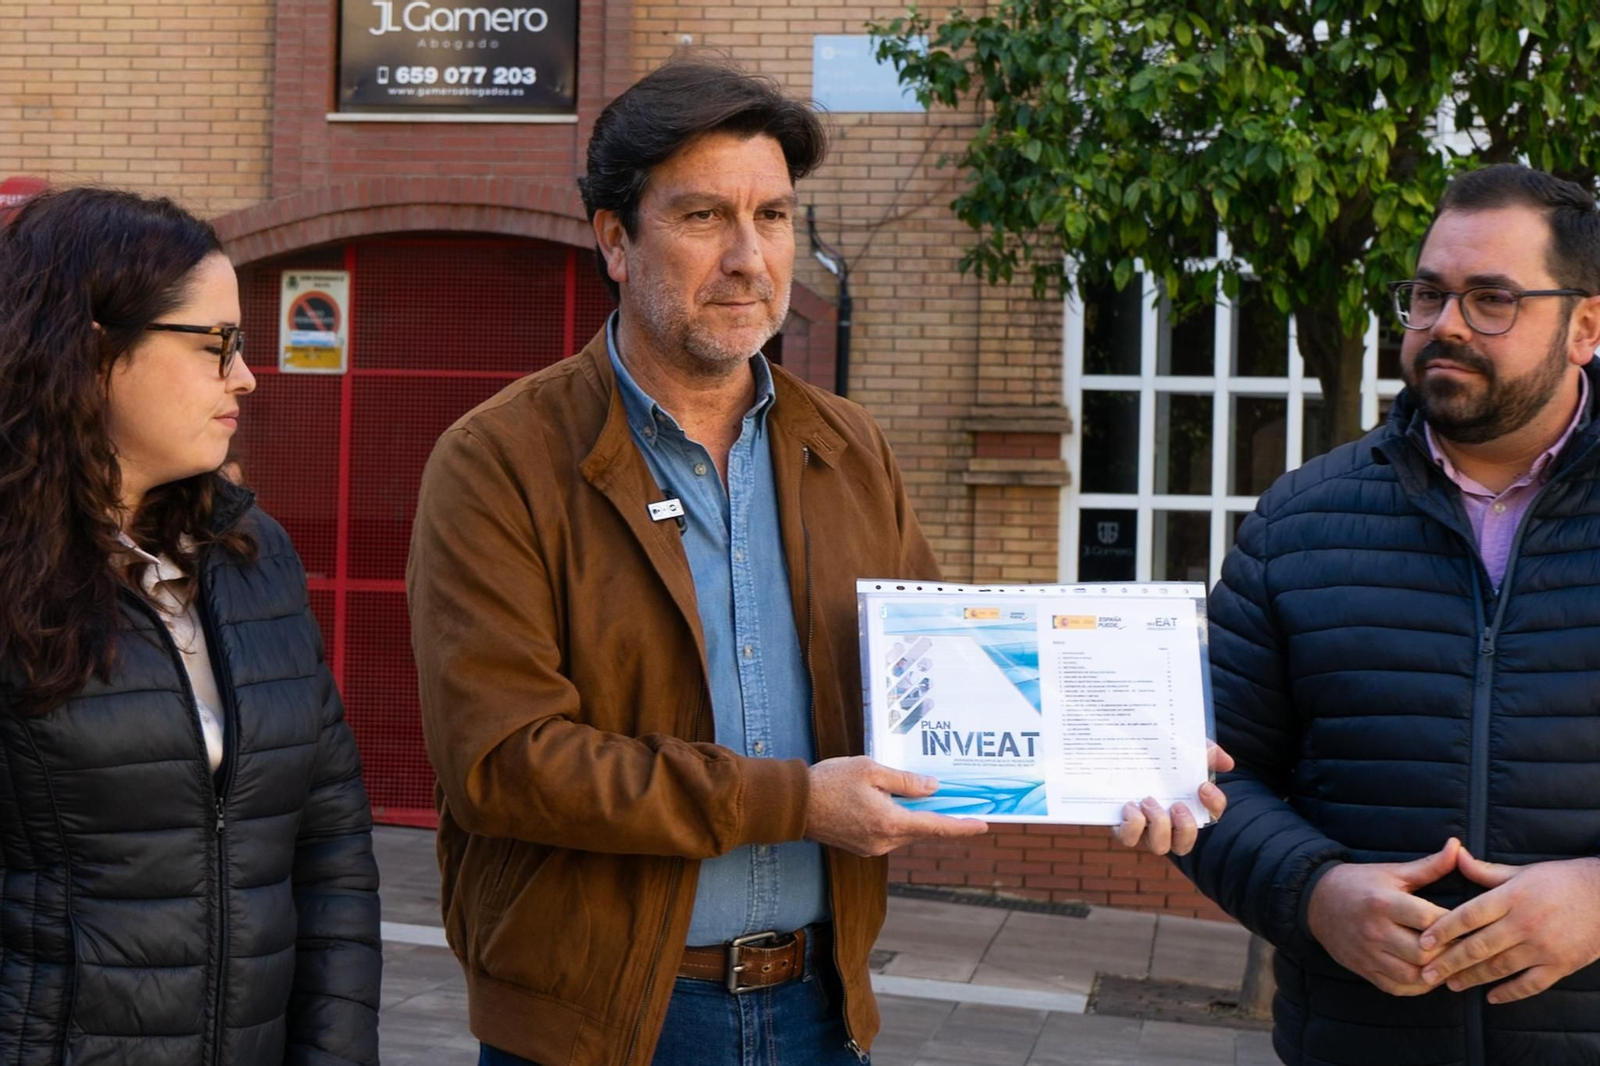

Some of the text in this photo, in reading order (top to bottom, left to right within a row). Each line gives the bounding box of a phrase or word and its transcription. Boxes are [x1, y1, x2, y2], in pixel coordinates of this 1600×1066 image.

[403, 1, 548, 33] Gamero
[417, 38, 499, 51] Abogado
[395, 66, 537, 85] 659 077 203
[921, 720, 951, 730] PLAN
[921, 730, 1040, 757] INVEAT
